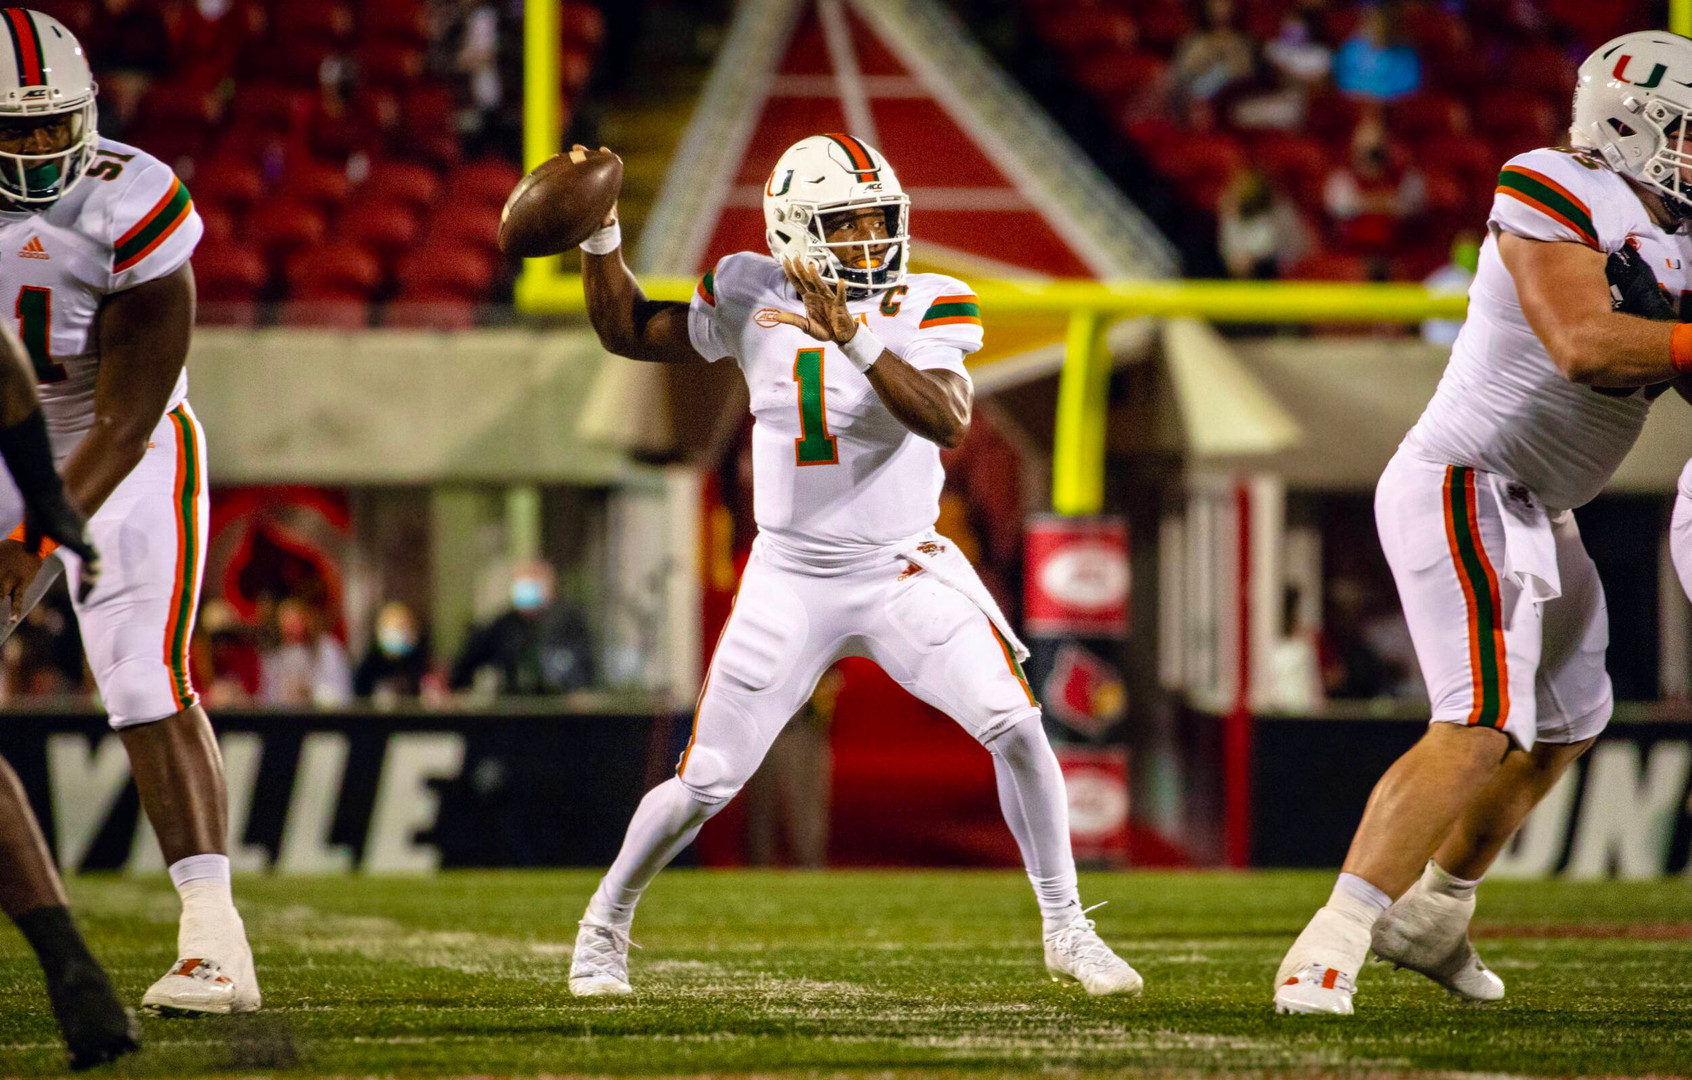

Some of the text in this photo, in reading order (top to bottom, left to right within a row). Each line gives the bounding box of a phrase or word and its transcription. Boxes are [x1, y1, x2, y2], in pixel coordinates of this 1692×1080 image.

[864, 182, 883, 190] ACC
[879, 284, 909, 317] C
[793, 347, 839, 467] 1
